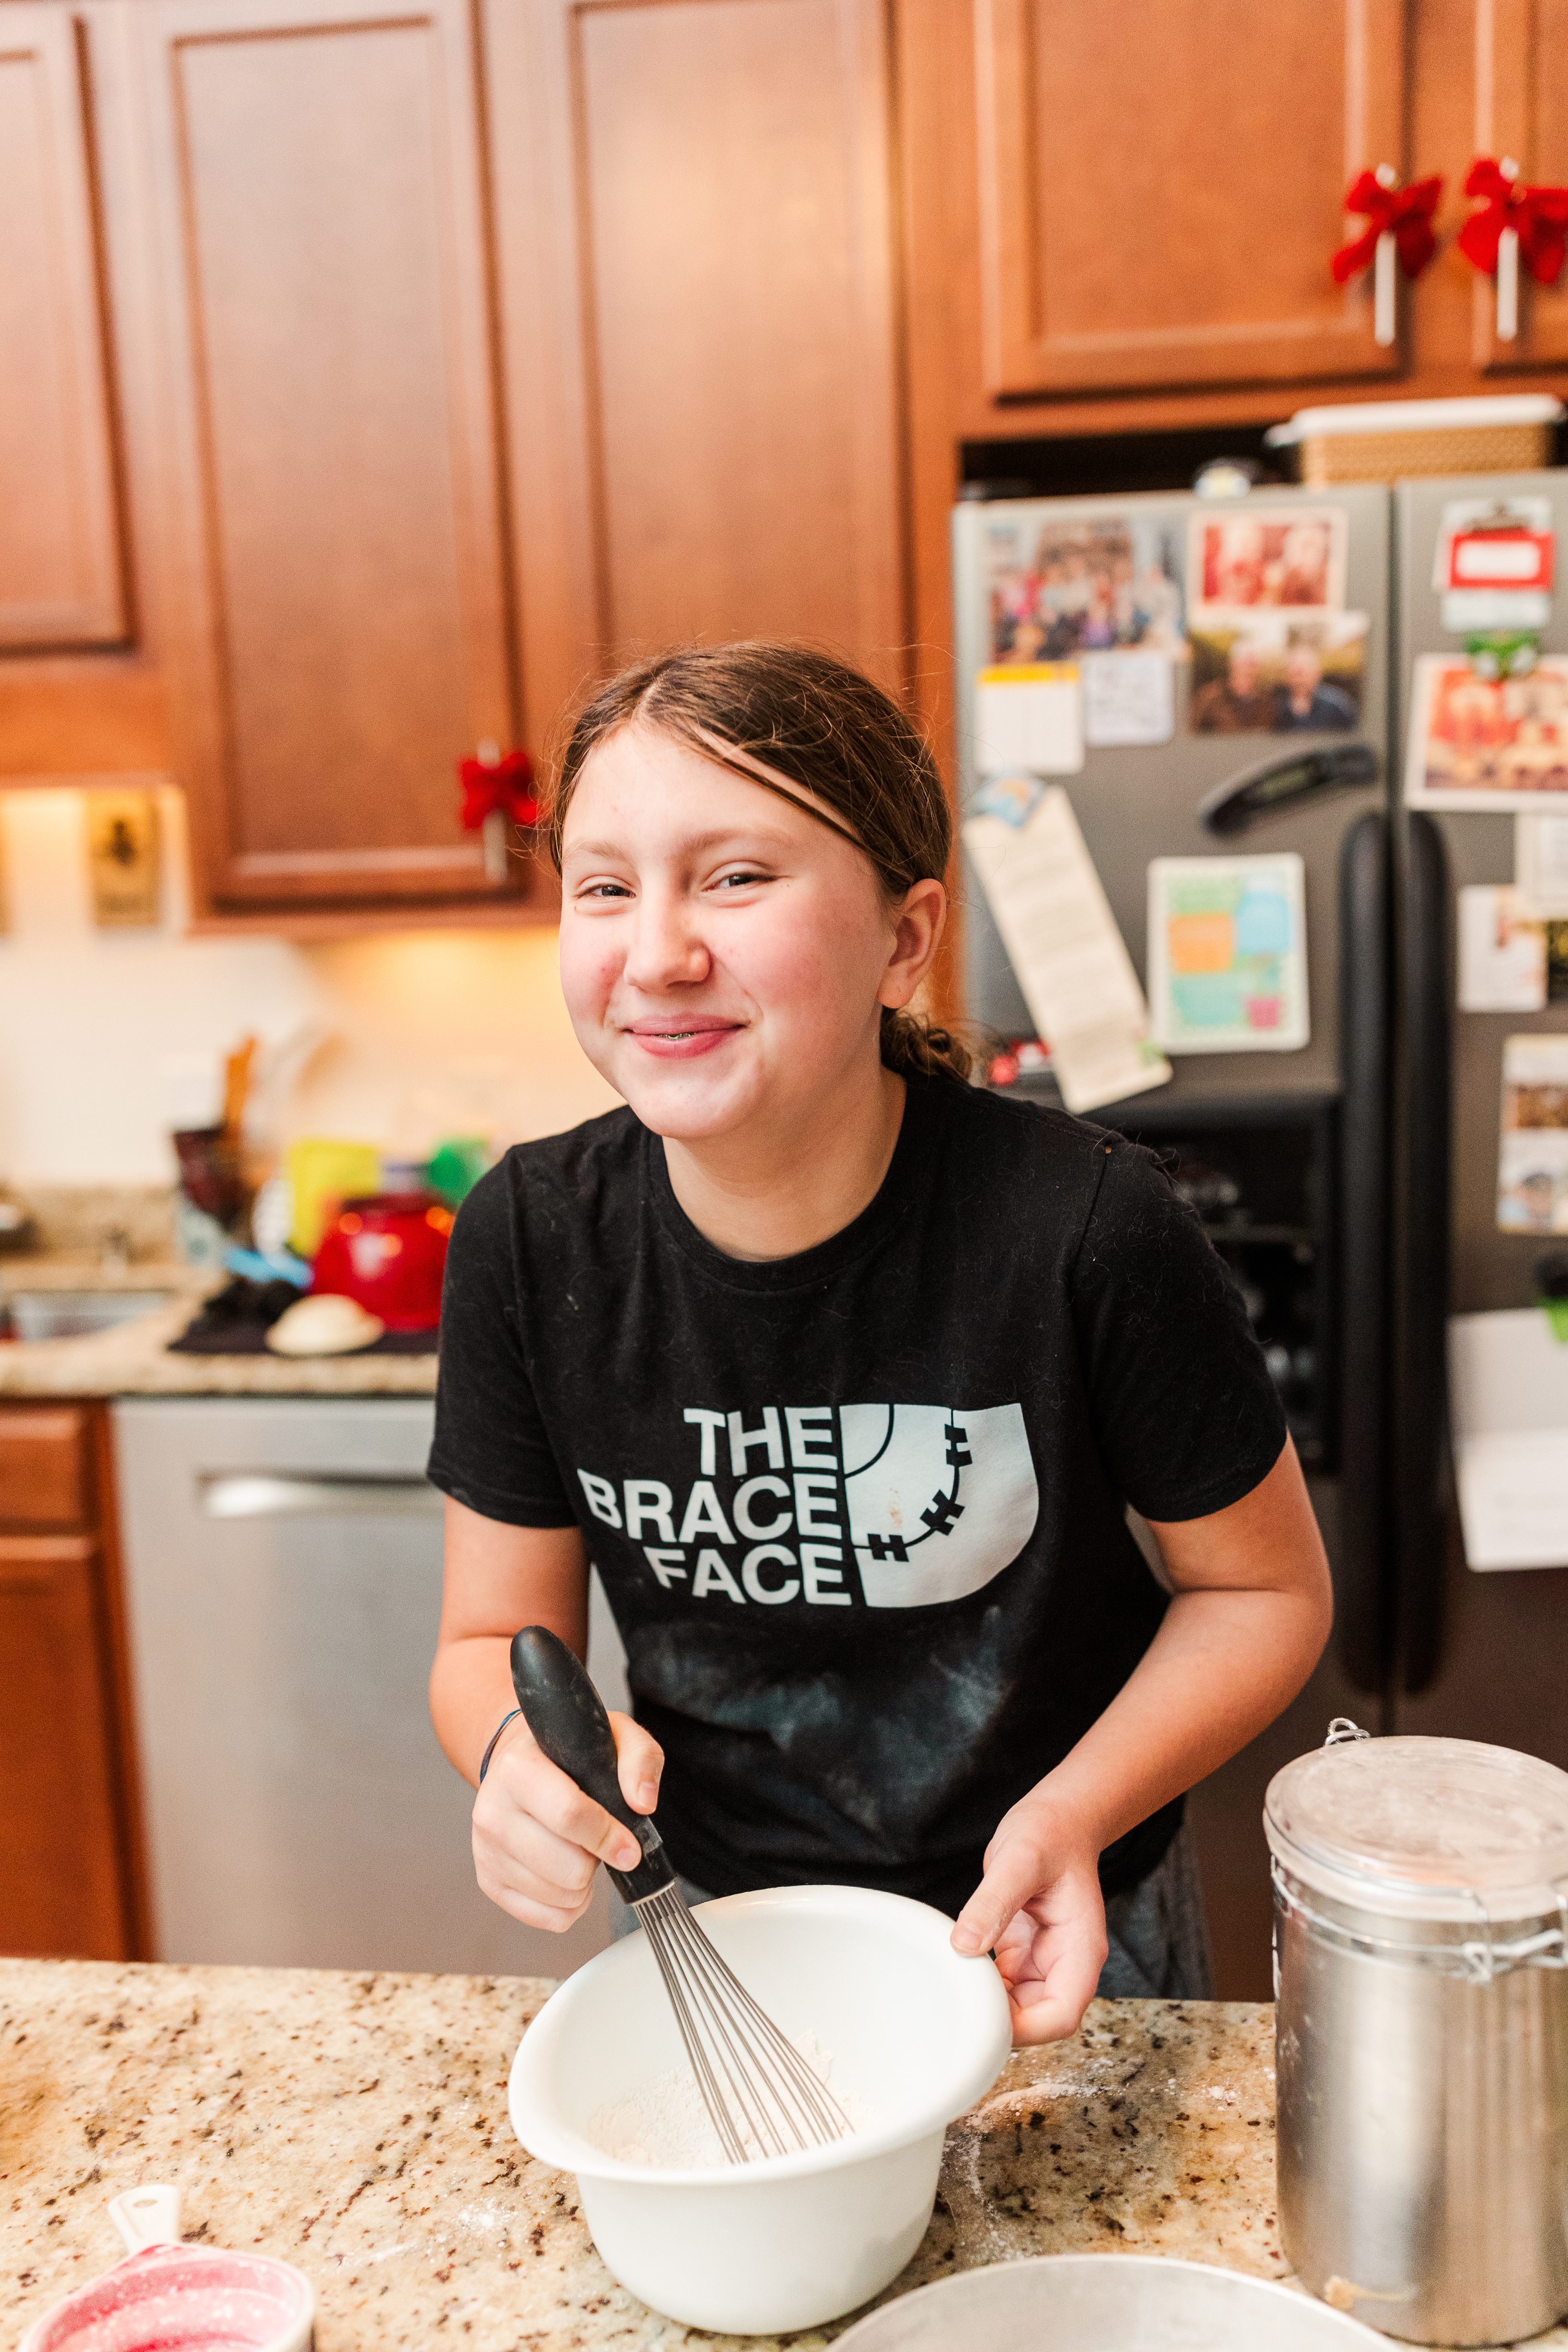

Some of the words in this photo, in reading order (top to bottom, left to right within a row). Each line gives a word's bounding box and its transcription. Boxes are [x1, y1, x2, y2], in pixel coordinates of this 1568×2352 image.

[683, 1406, 838, 1477] THE
[577, 1469, 842, 1544] BRACE
[643, 1543, 852, 1606] FACE
